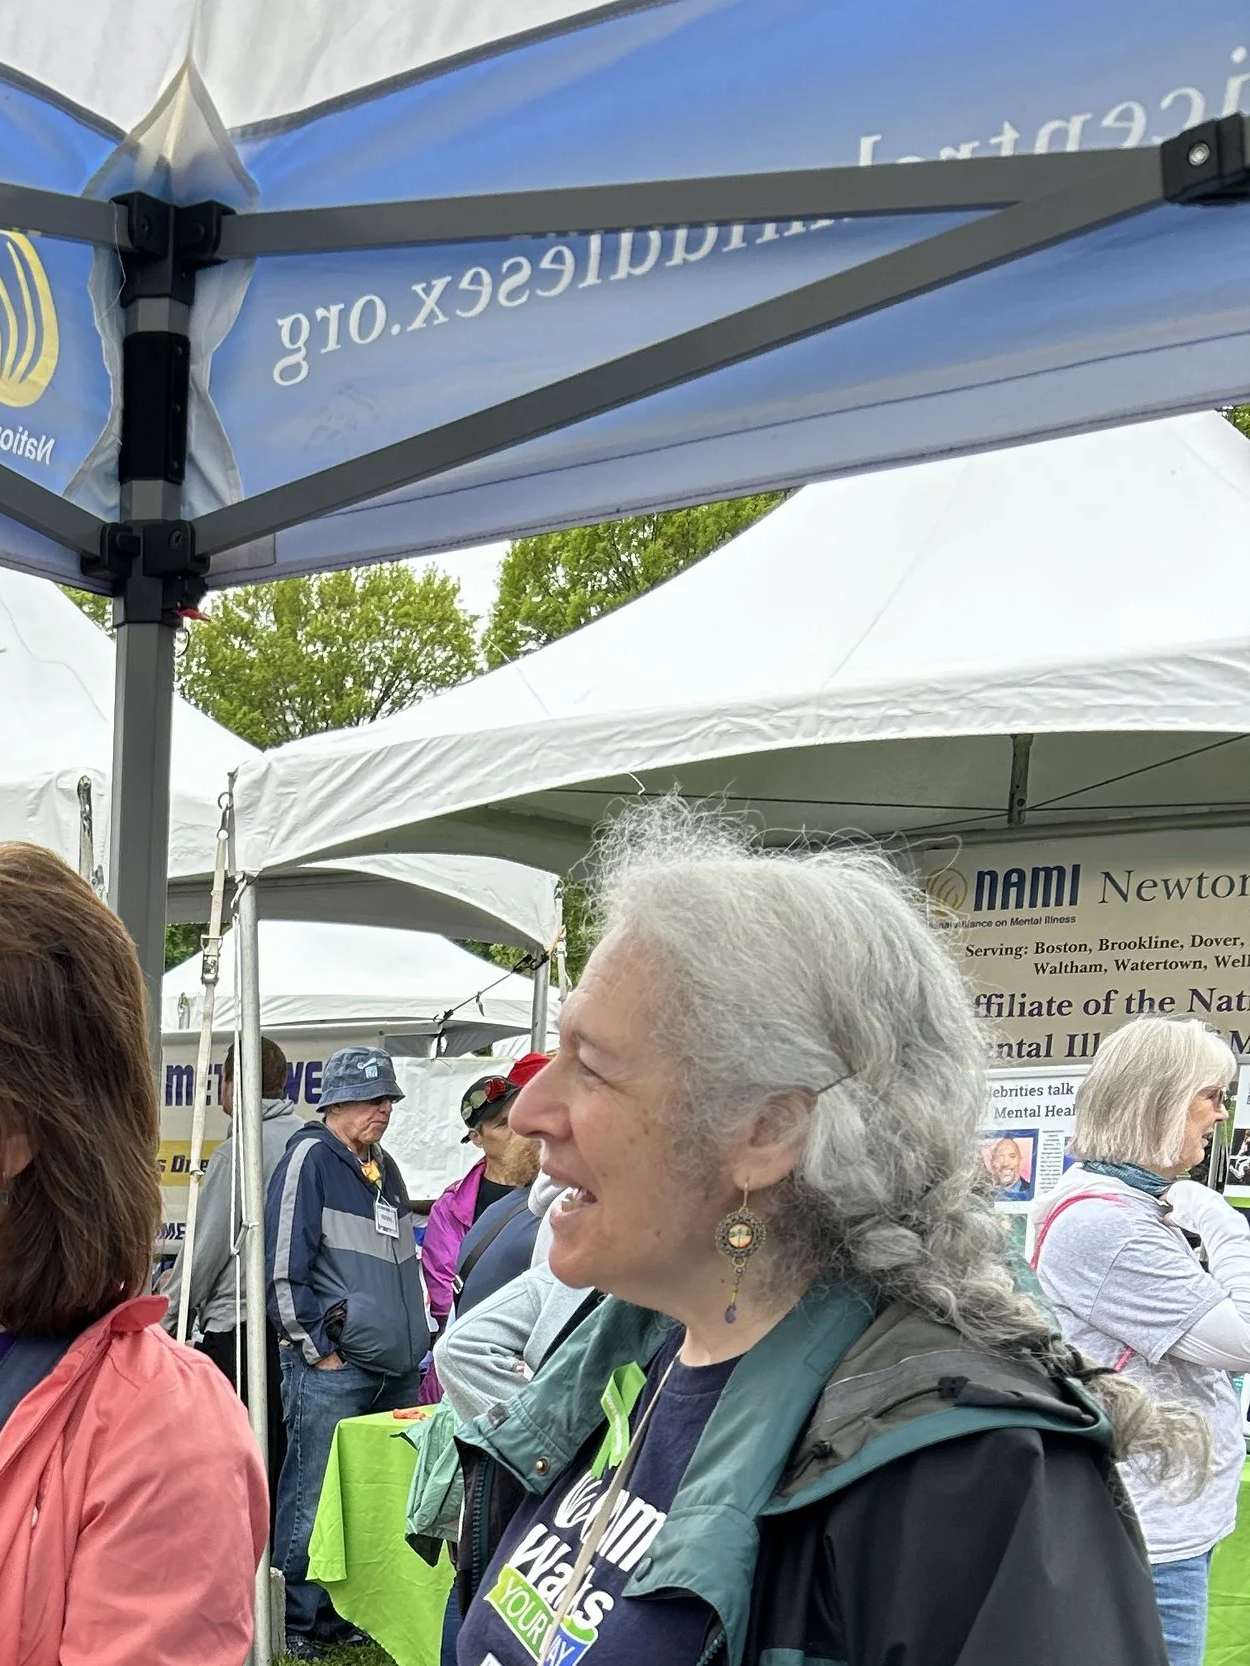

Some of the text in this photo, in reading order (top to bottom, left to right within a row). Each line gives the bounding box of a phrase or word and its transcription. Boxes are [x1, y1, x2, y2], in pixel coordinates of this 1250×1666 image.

[973, 863, 1081, 912] NAMI
[995, 919, 1008, 928] on
[1010, 916, 1042, 927] Mental
[1044, 915, 1077, 924] Illness
[965, 934, 1245, 960] Serving: Boston, Brookline, Dover,
[1034, 960, 1108, 975] Waltham,
[1114, 958, 1208, 973] Watertown,
[973, 992, 1073, 1018] ffiliate
[1083, 990, 1119, 1015] of
[1125, 988, 1176, 1015] the
[991, 1082, 1075, 1099] ebrities talk
[993, 1105, 1041, 1119] Mental
[499, 1575, 549, 1645] YOUR
